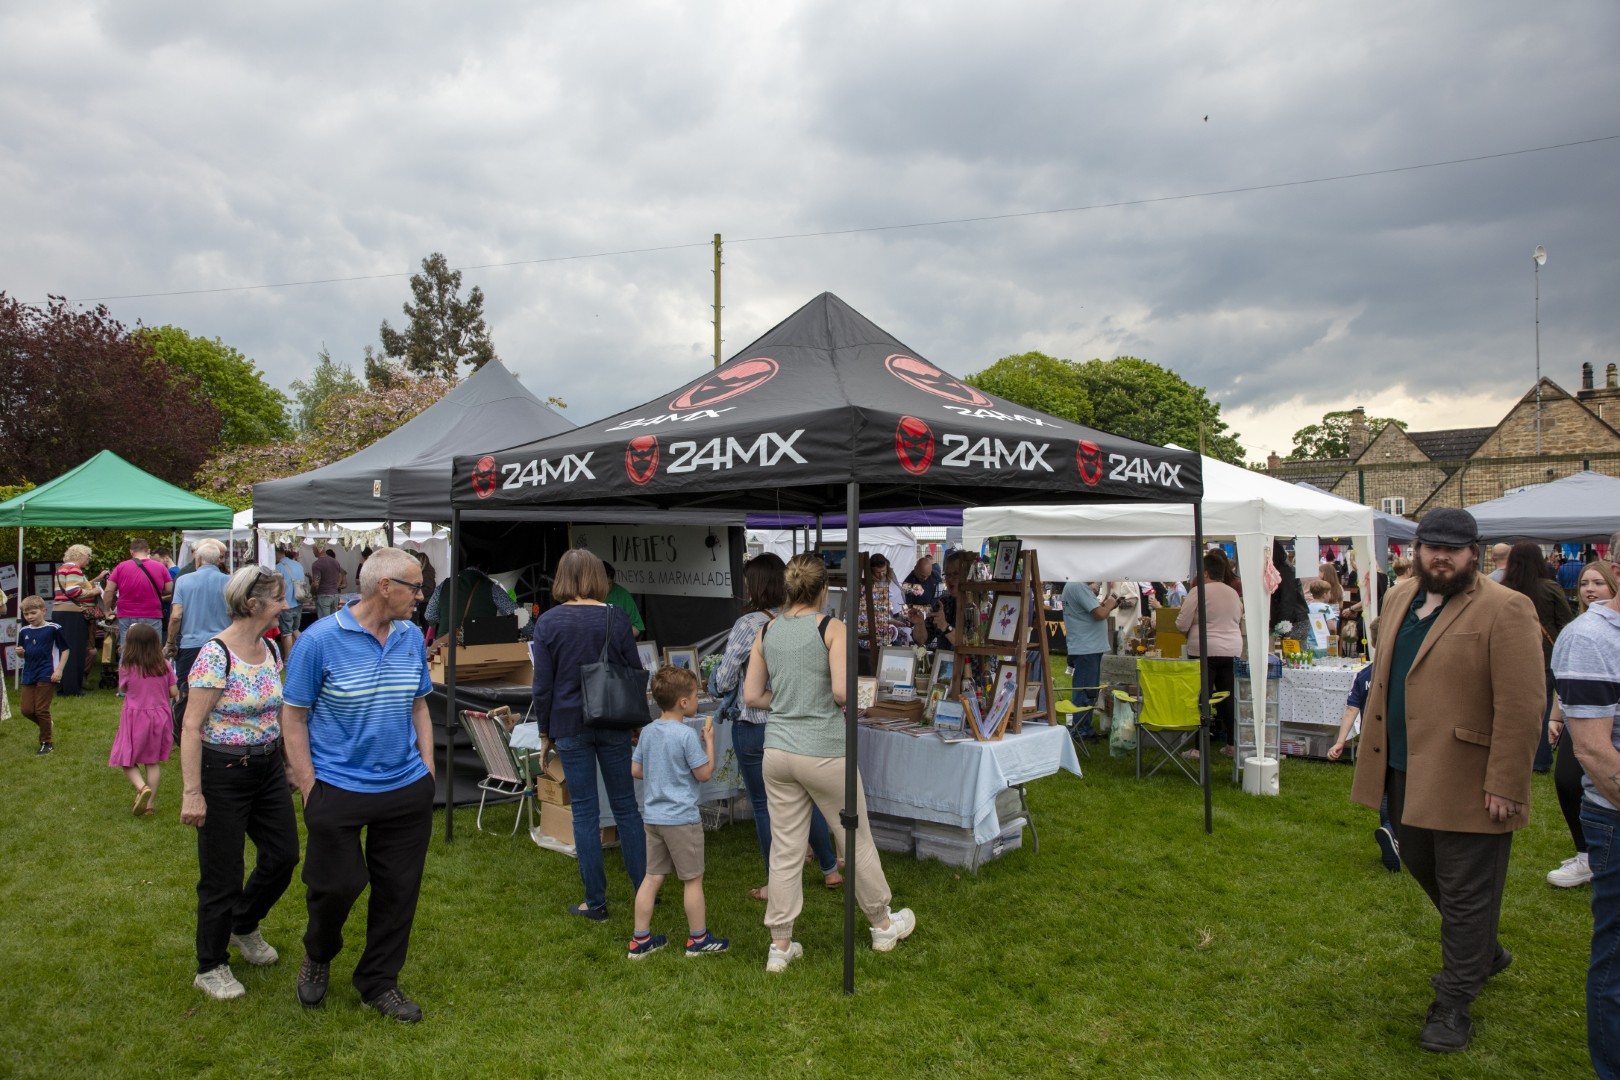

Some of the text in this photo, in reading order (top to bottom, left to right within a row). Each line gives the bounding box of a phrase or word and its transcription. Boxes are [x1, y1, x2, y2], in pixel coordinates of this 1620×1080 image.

[666, 428, 809, 474] 24MX
[941, 433, 1055, 473] 24MX
[501, 451, 597, 490] 24MX
[1108, 453, 1185, 489] 24MX
[612, 534, 677, 563] MARIE'S
[648, 570, 656, 584] &
[659, 570, 731, 587] MARMALADE
